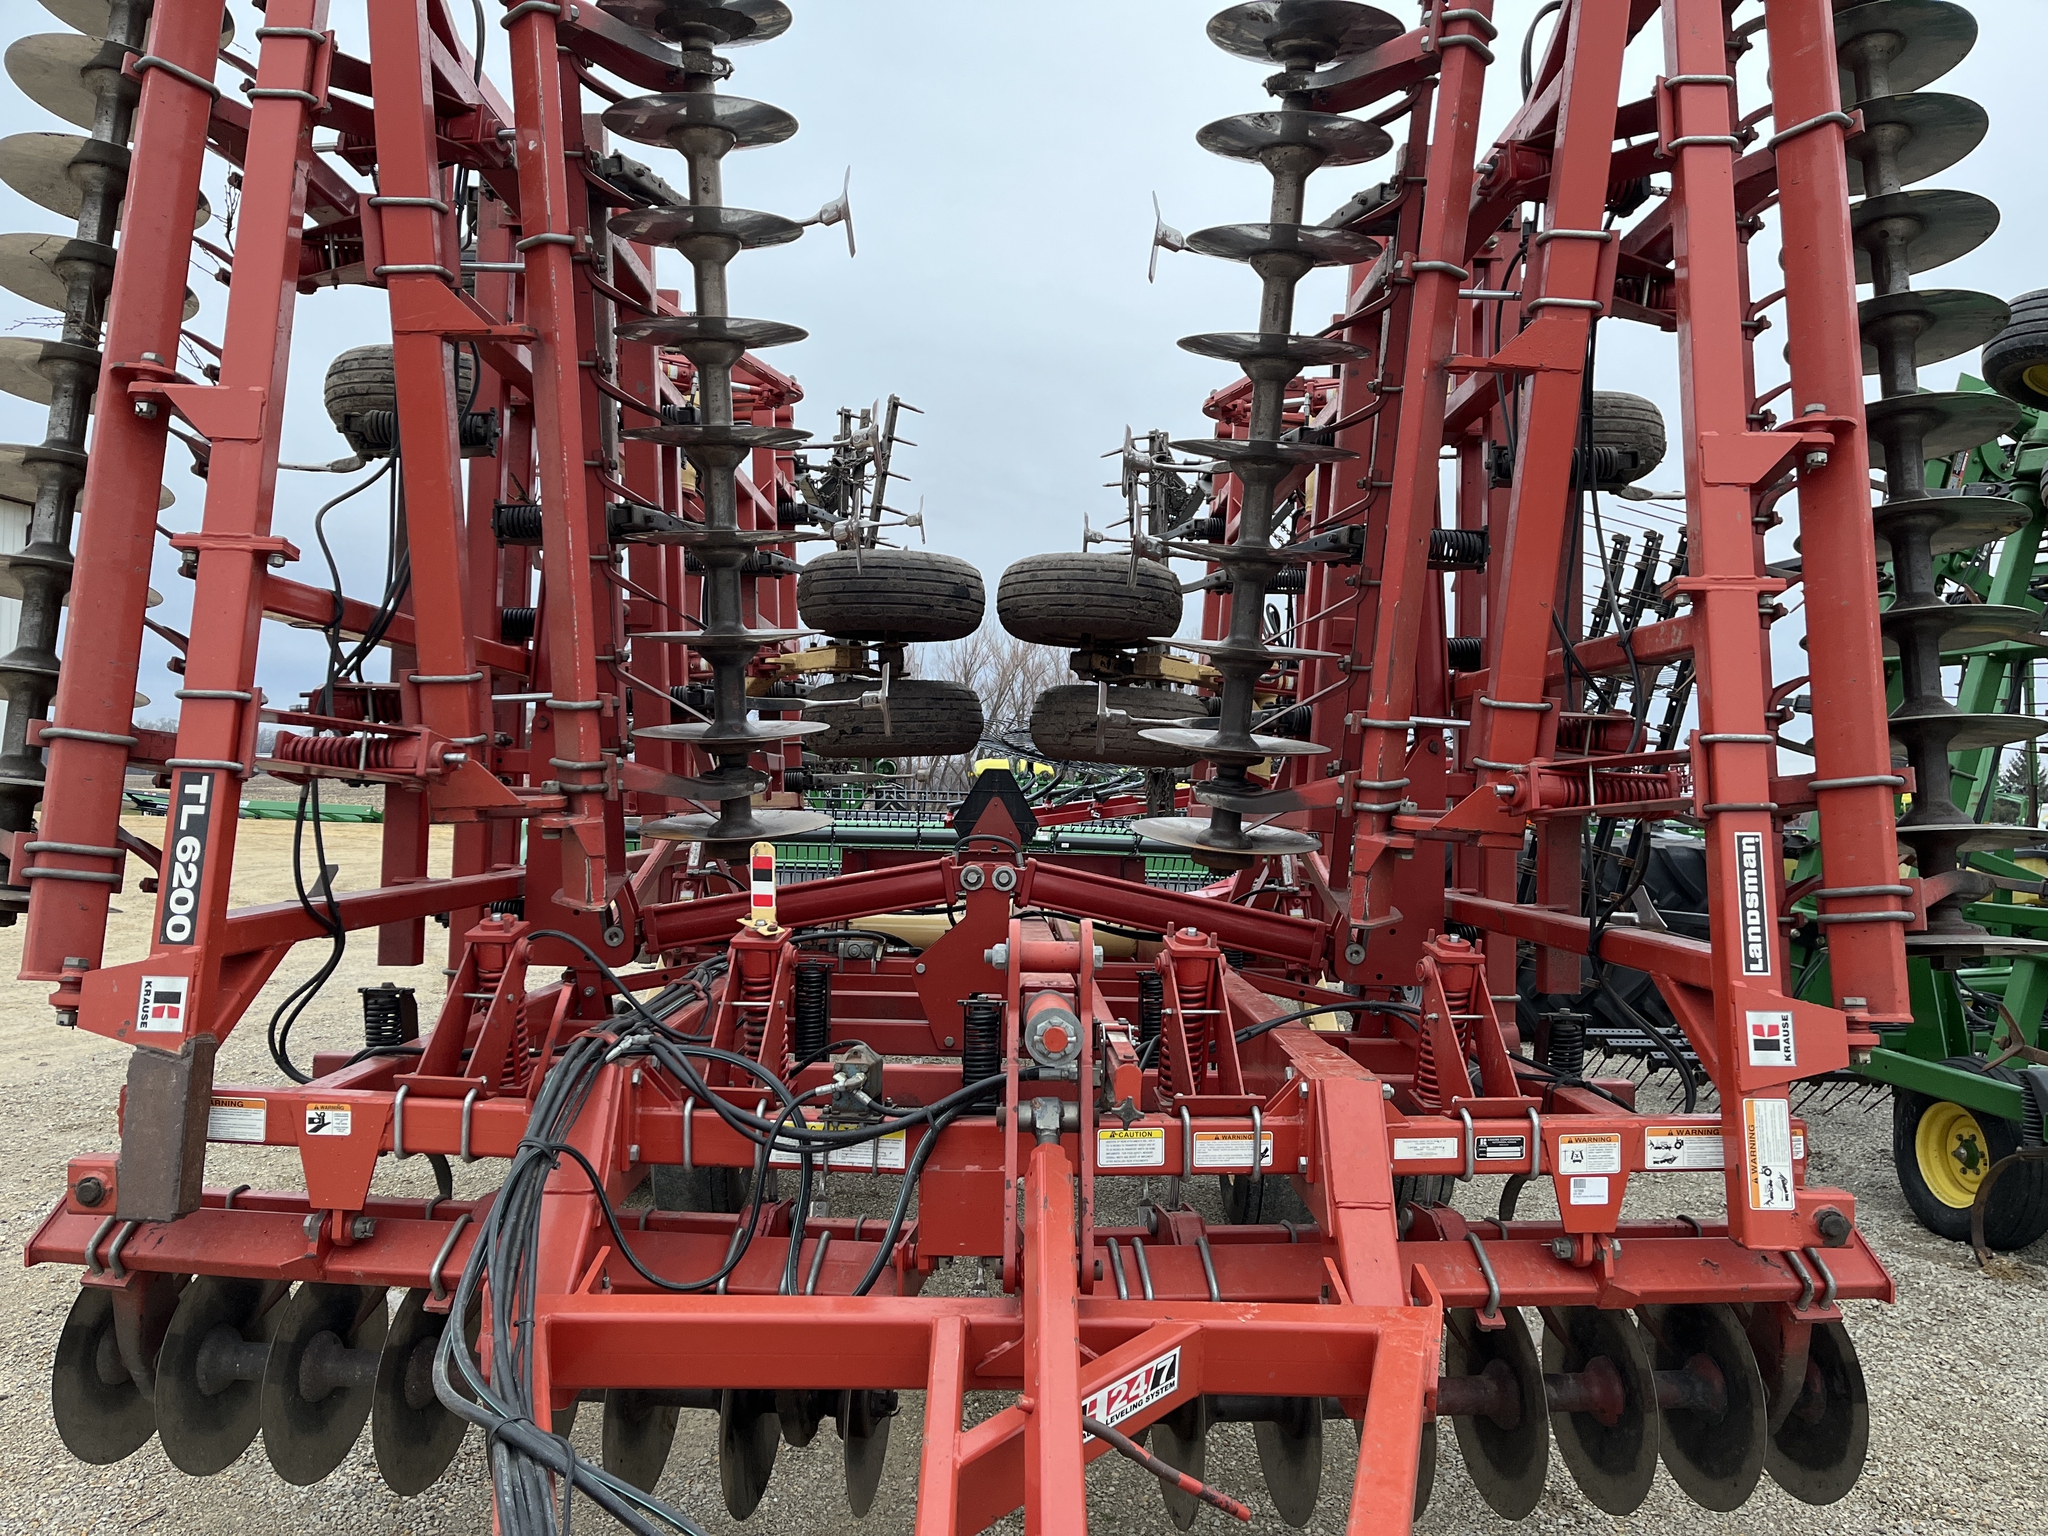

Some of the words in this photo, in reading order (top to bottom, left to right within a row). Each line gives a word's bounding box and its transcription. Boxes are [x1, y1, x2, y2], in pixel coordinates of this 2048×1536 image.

[179, 775, 209, 830] TL
[166, 836, 201, 942] 6200
[139, 980, 153, 1029] KRAUSE
[1781, 1014, 1792, 1062] KRAUSE
[210, 1099, 244, 1108] ARNING
[1676, 1128, 1720, 1136] WARNING
[1748, 1124, 1758, 1174] WARNING
[1105, 1398, 1144, 1426] LEVELING
[1145, 1380, 1176, 1403] SYSTEM
